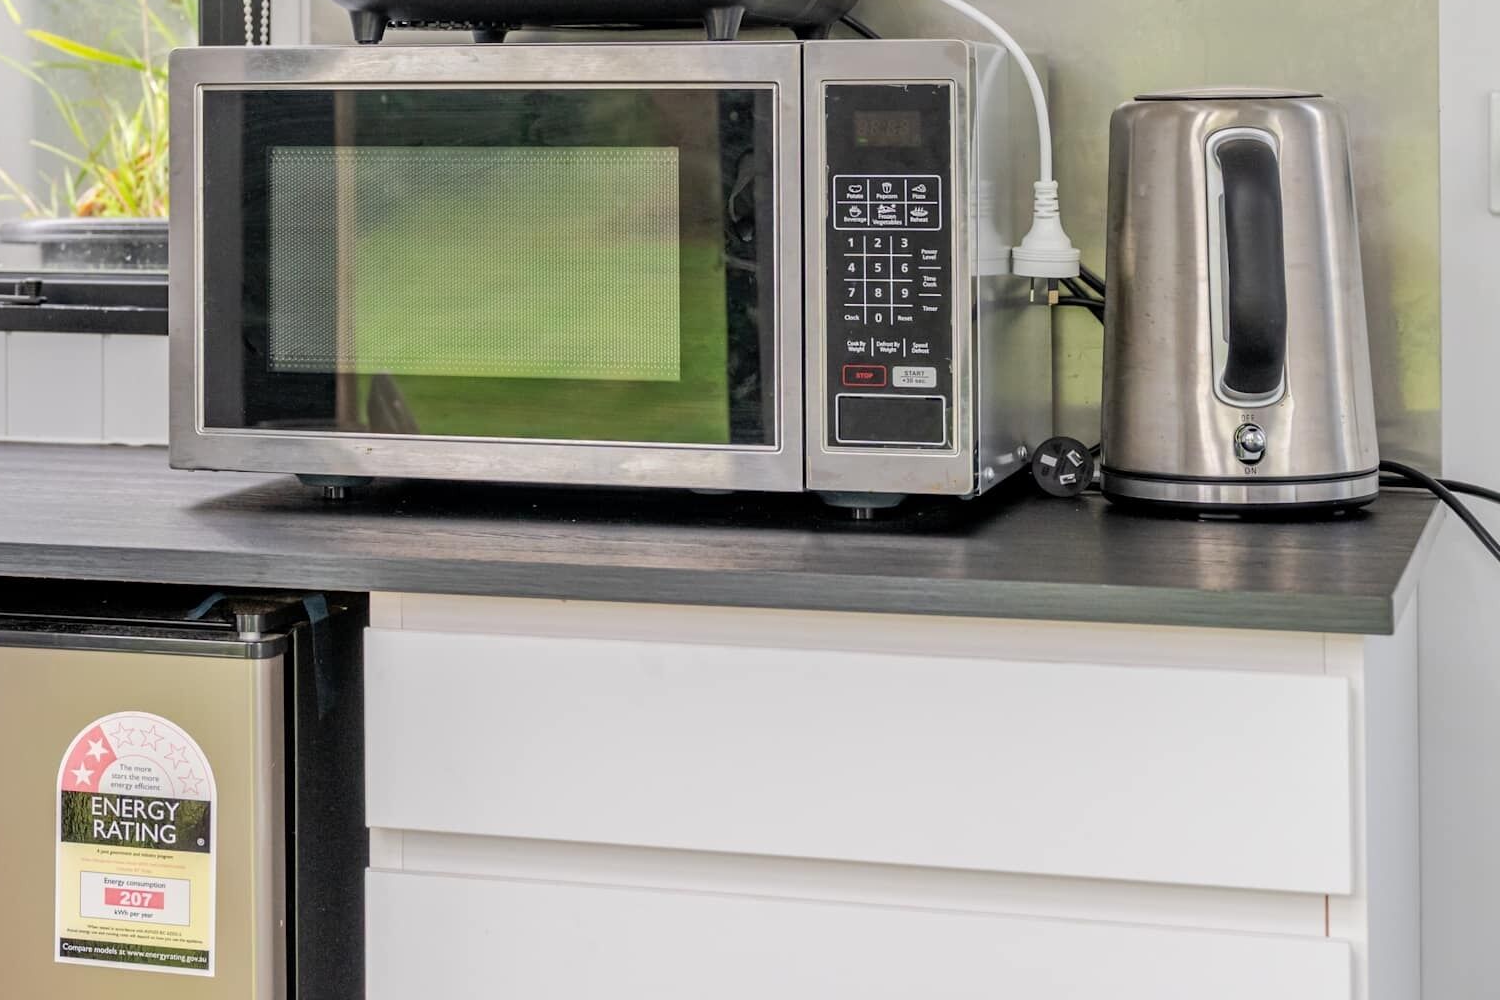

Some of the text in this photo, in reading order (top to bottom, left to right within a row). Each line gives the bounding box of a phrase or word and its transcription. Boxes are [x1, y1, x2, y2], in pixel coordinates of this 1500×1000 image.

[847, 237, 854, 248] 1
[873, 237, 882, 248] 2
[900, 237, 909, 248] 3
[847, 262, 856, 273] 4
[874, 262, 882, 273] 5
[900, 262, 909, 273] 6
[847, 287, 856, 298] 7
[874, 287, 882, 298] 8
[901, 288, 909, 298] 9
[874, 312, 883, 323] 0
[855, 371, 874, 380] STOP
[1241, 414, 1255, 422] OFF
[1244, 466, 1257, 475] ON
[119, 763, 132, 771] The
[111, 772, 127, 780] stars
[110, 782, 161, 791] energy efficient
[91, 796, 180, 822] ENERGY
[93, 819, 177, 845] RATING
[103, 876, 166, 889] Energy consumption
[119, 890, 154, 907] 207
[113, 908, 154, 920] kWh per year
[62, 942, 208, 964] Compare models at www.energyrating.gov.au
